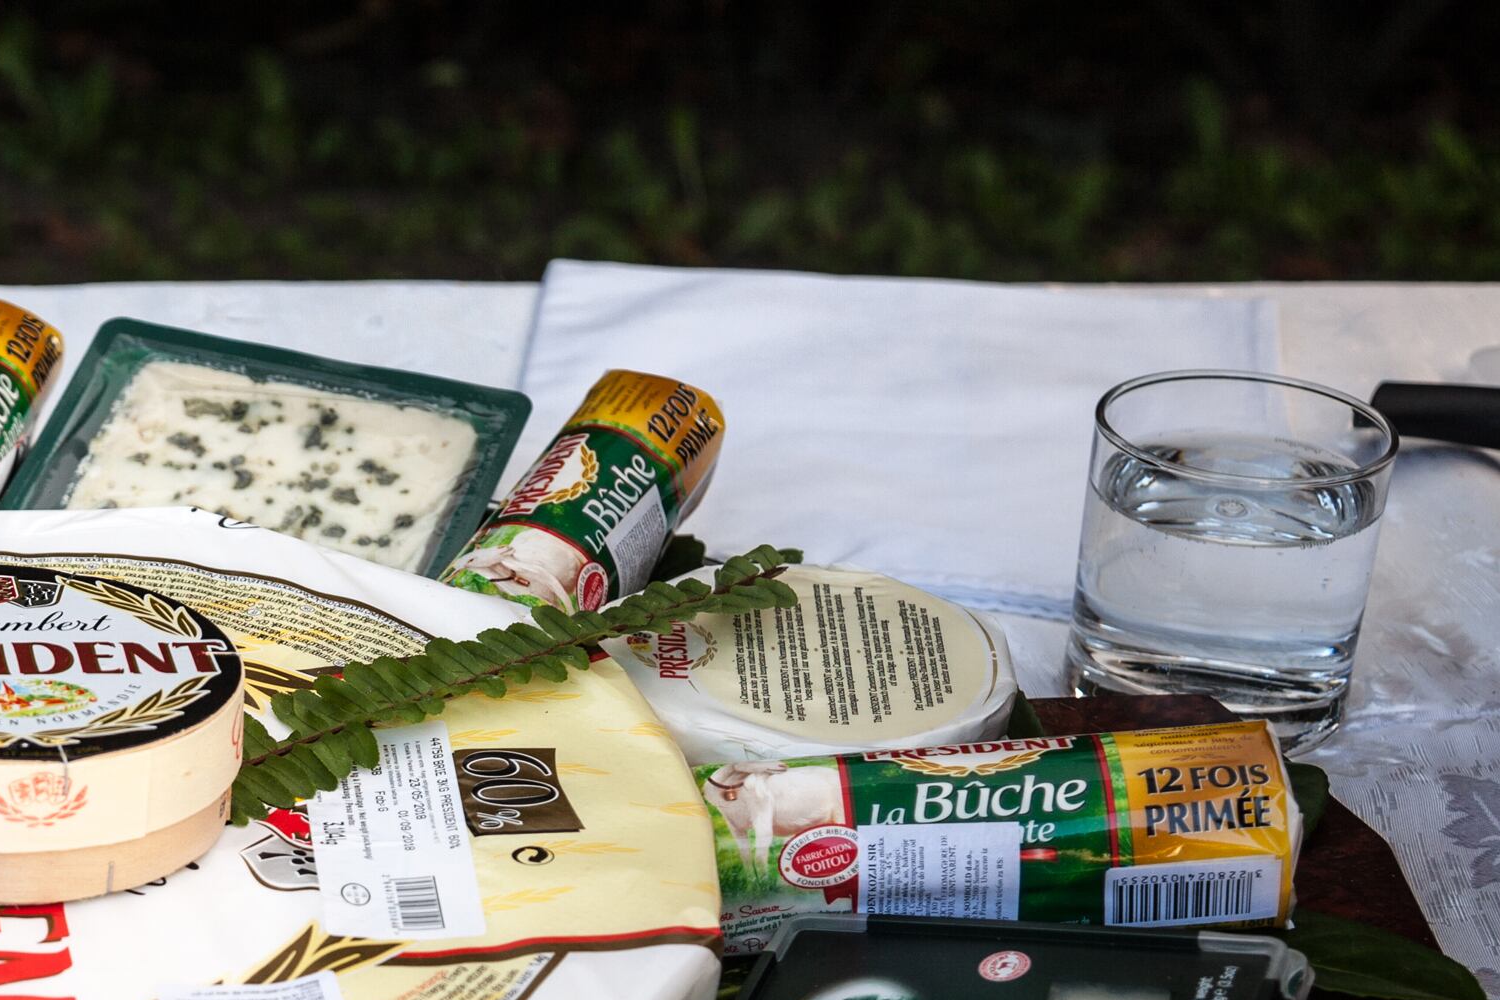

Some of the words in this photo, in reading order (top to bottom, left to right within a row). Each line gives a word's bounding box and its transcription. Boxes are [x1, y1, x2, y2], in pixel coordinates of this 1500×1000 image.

[648, 416, 671, 444] 12
[665, 383, 699, 424] FOIS
[500, 433, 590, 518] PRÉSIDENT
[582, 454, 656, 531] Bûche
[585, 530, 608, 555] La
[653, 619, 694, 679] PRÉSIDE
[36, 683, 142, 724] NORMANDIE
[864, 736, 1076, 763] PRÉSIDENT
[433, 760, 447, 777] BRIE
[440, 794, 458, 832] PRESIDENT
[462, 751, 560, 807] 60
[1137, 767, 1185, 795] 12
[1190, 764, 1270, 791] FOIS
[870, 802, 905, 826] La
[914, 776, 1088, 825] Bûche
[1144, 790, 1271, 837] PRIMÉE
[785, 834, 812, 861] LAITERIE
[812, 829, 824, 839] DE
[796, 843, 852, 864] FABRICATION
[867, 843, 877, 859] SIR
[796, 876, 831, 887] FONDÉE
[834, 875, 846, 883] EN
[803, 853, 850, 874] POITOU
[867, 860, 878, 890] KOZJI
